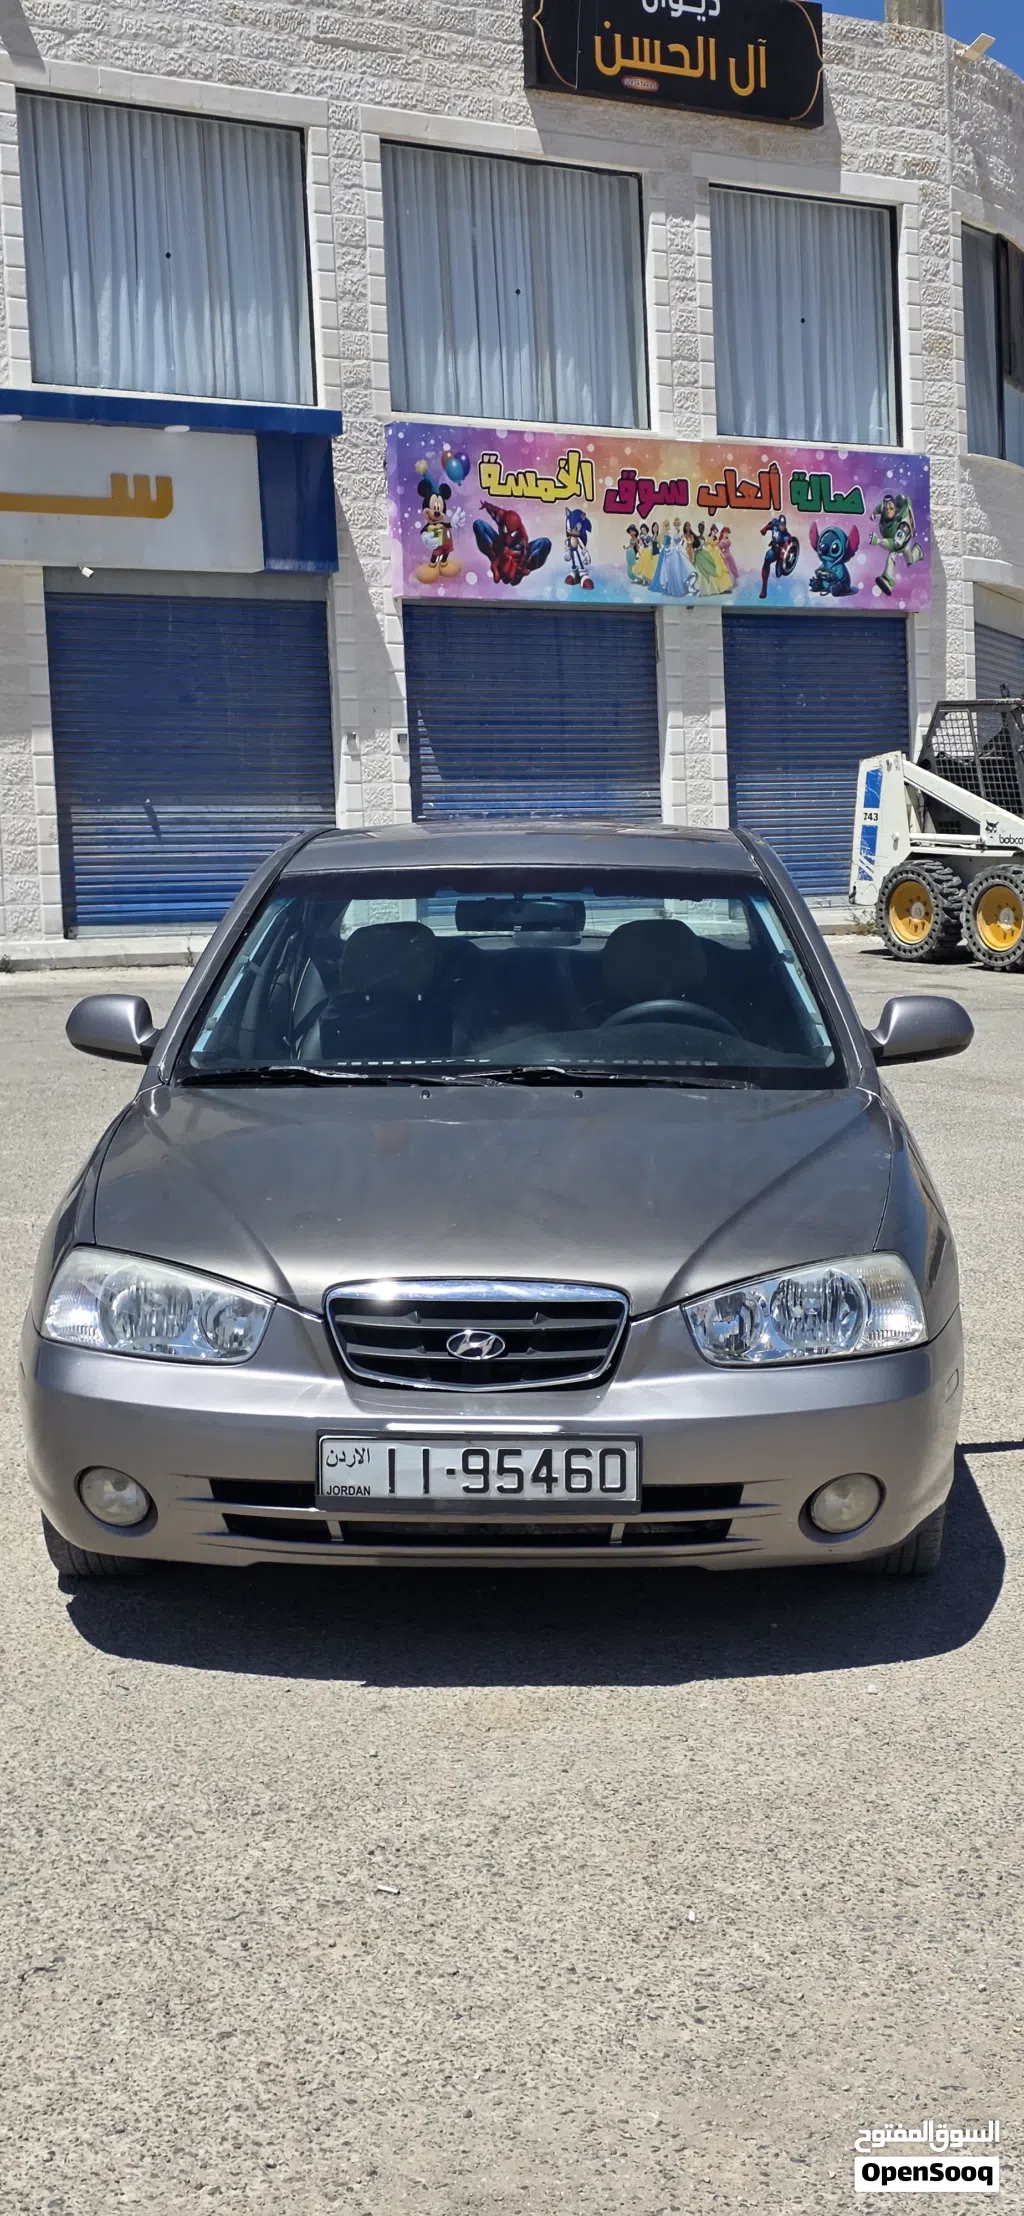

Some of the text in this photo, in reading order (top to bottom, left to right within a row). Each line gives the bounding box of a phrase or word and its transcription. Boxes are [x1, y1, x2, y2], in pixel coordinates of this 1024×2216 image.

[594, 20, 767, 97] آل الحسن
[478, 450, 595, 503] الخمسة
[602, 469, 691, 518] سوق
[790, 471, 867, 514] صالة
[863, 812, 879, 822] 743
[998, 833, 1024, 845] bobca
[326, 1447, 371, 1467] الاردن
[326, 1485, 371, 1496] JORDAN
